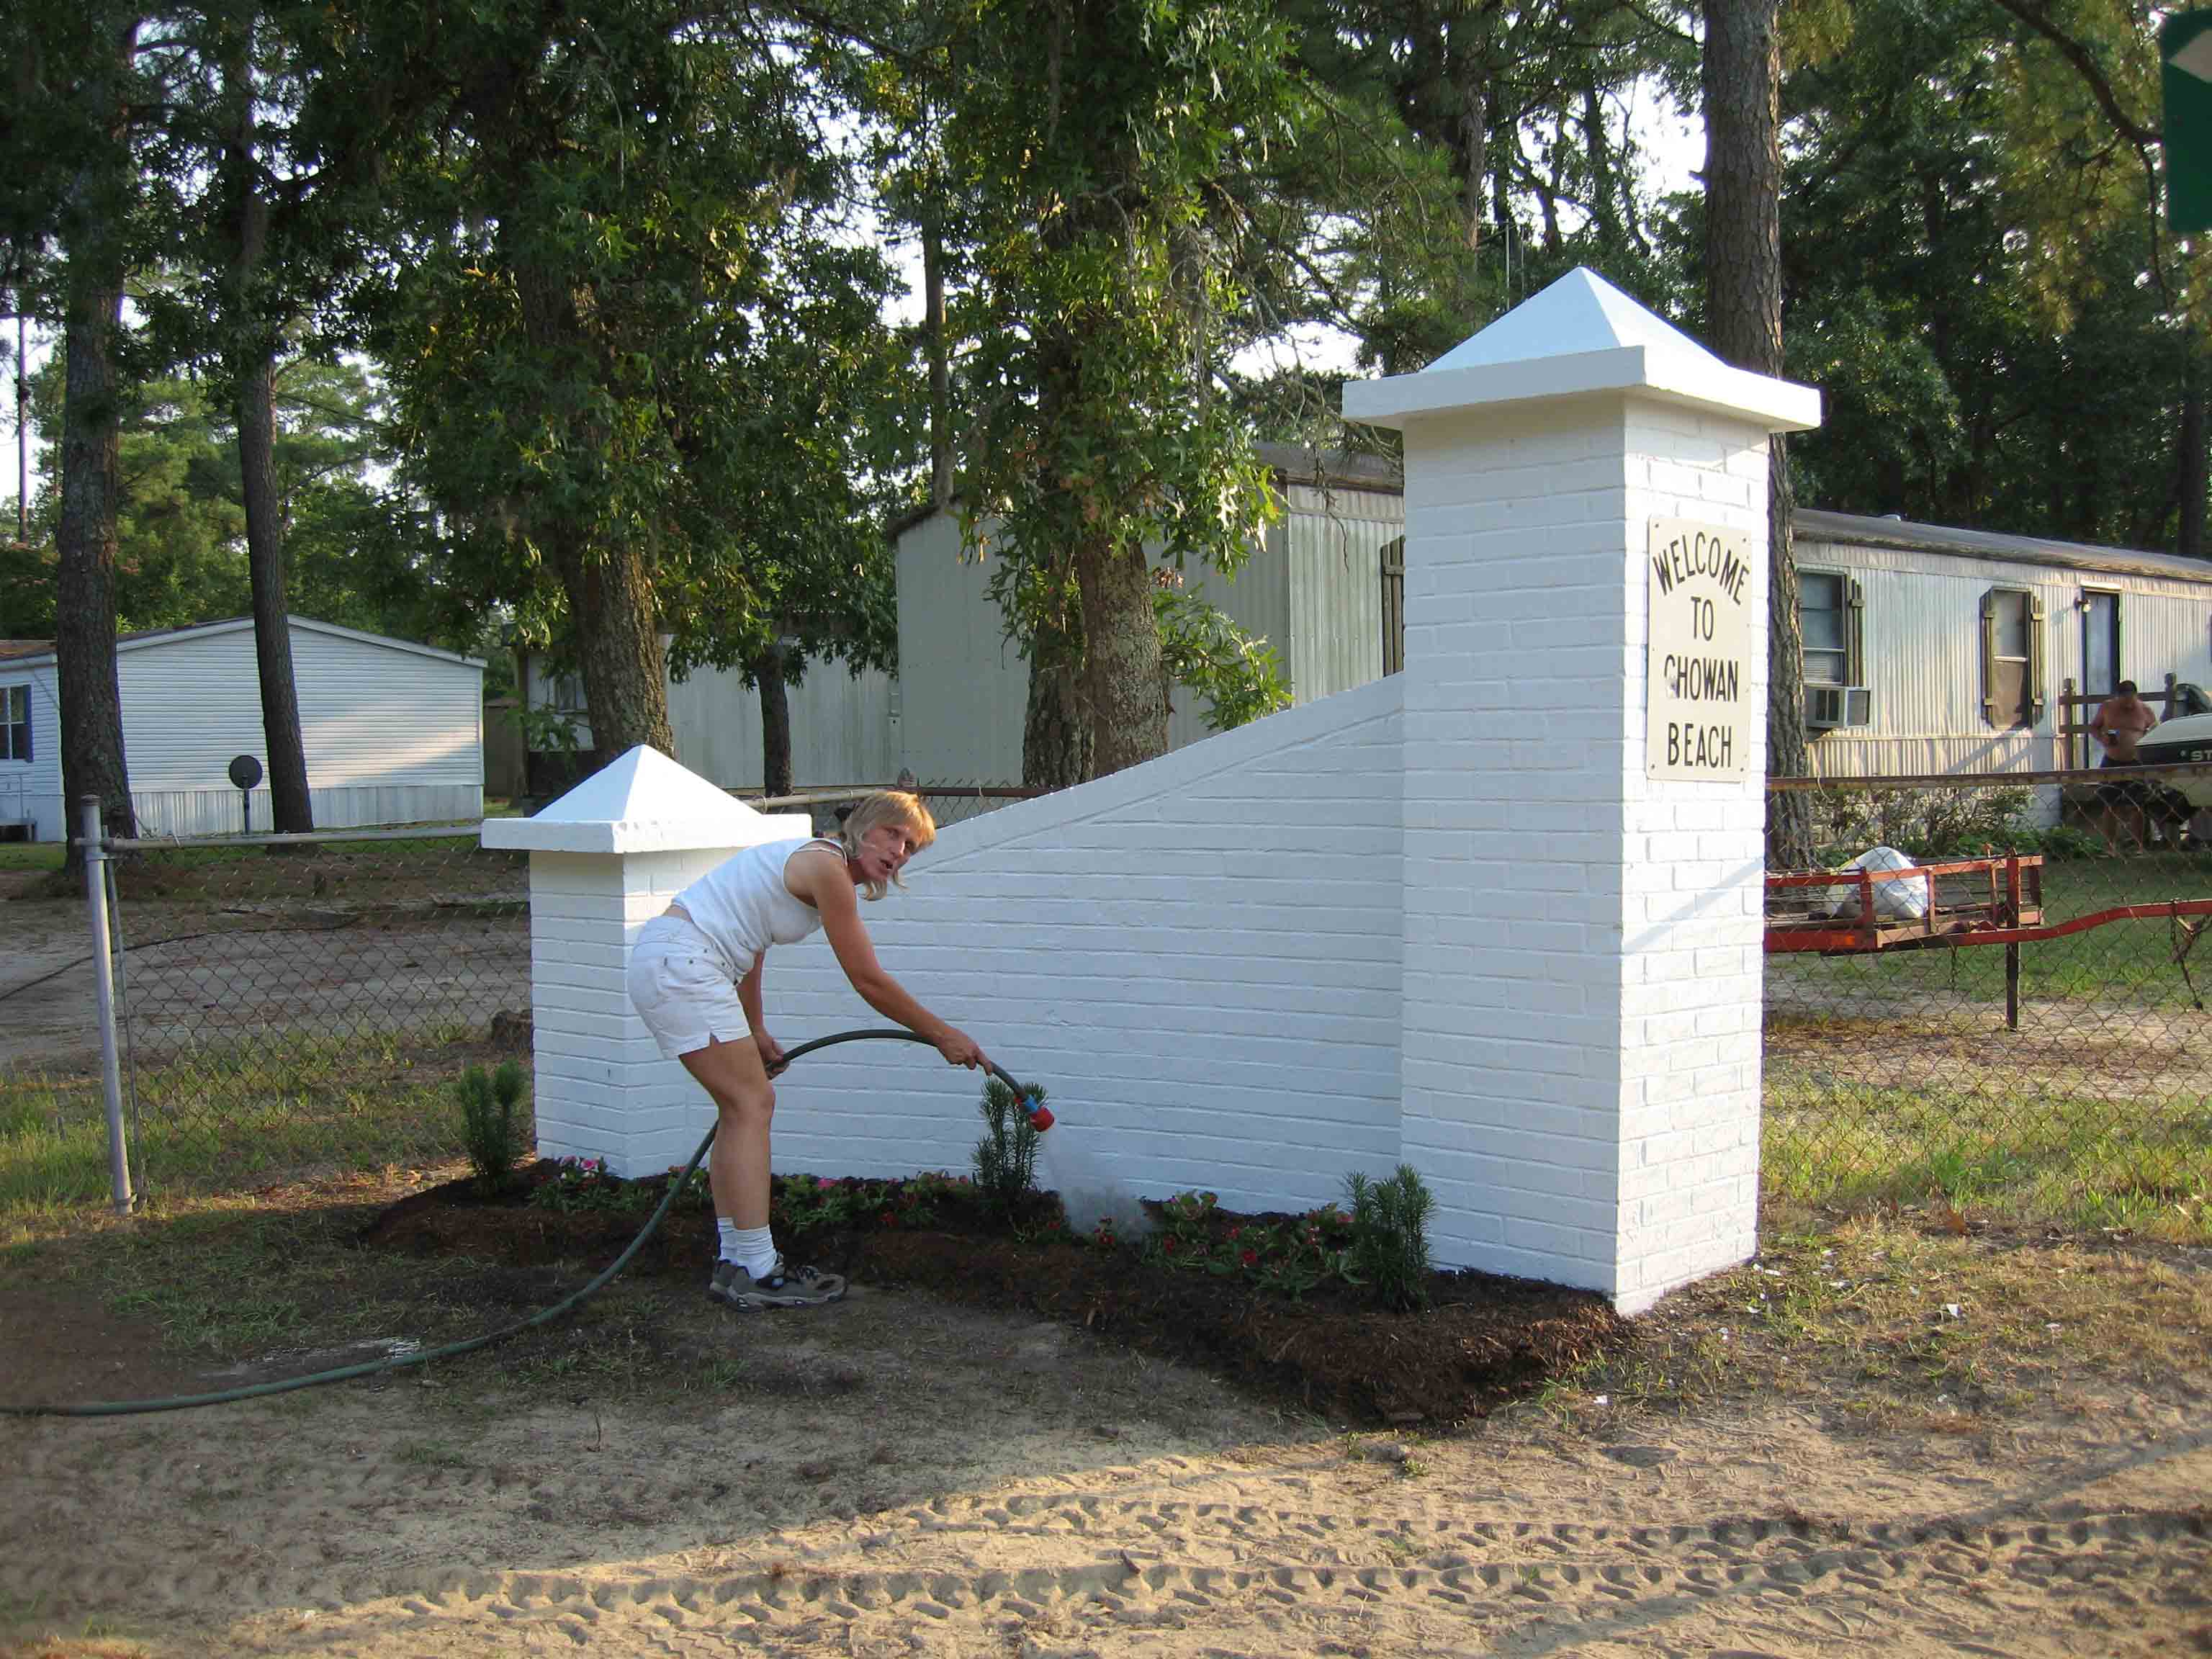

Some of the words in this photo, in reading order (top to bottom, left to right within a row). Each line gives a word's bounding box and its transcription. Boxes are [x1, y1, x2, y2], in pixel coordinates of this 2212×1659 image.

[1653, 531, 1750, 605] WELCOME
[1691, 596, 1714, 641] TO
[1668, 722, 1732, 768] BEACH
